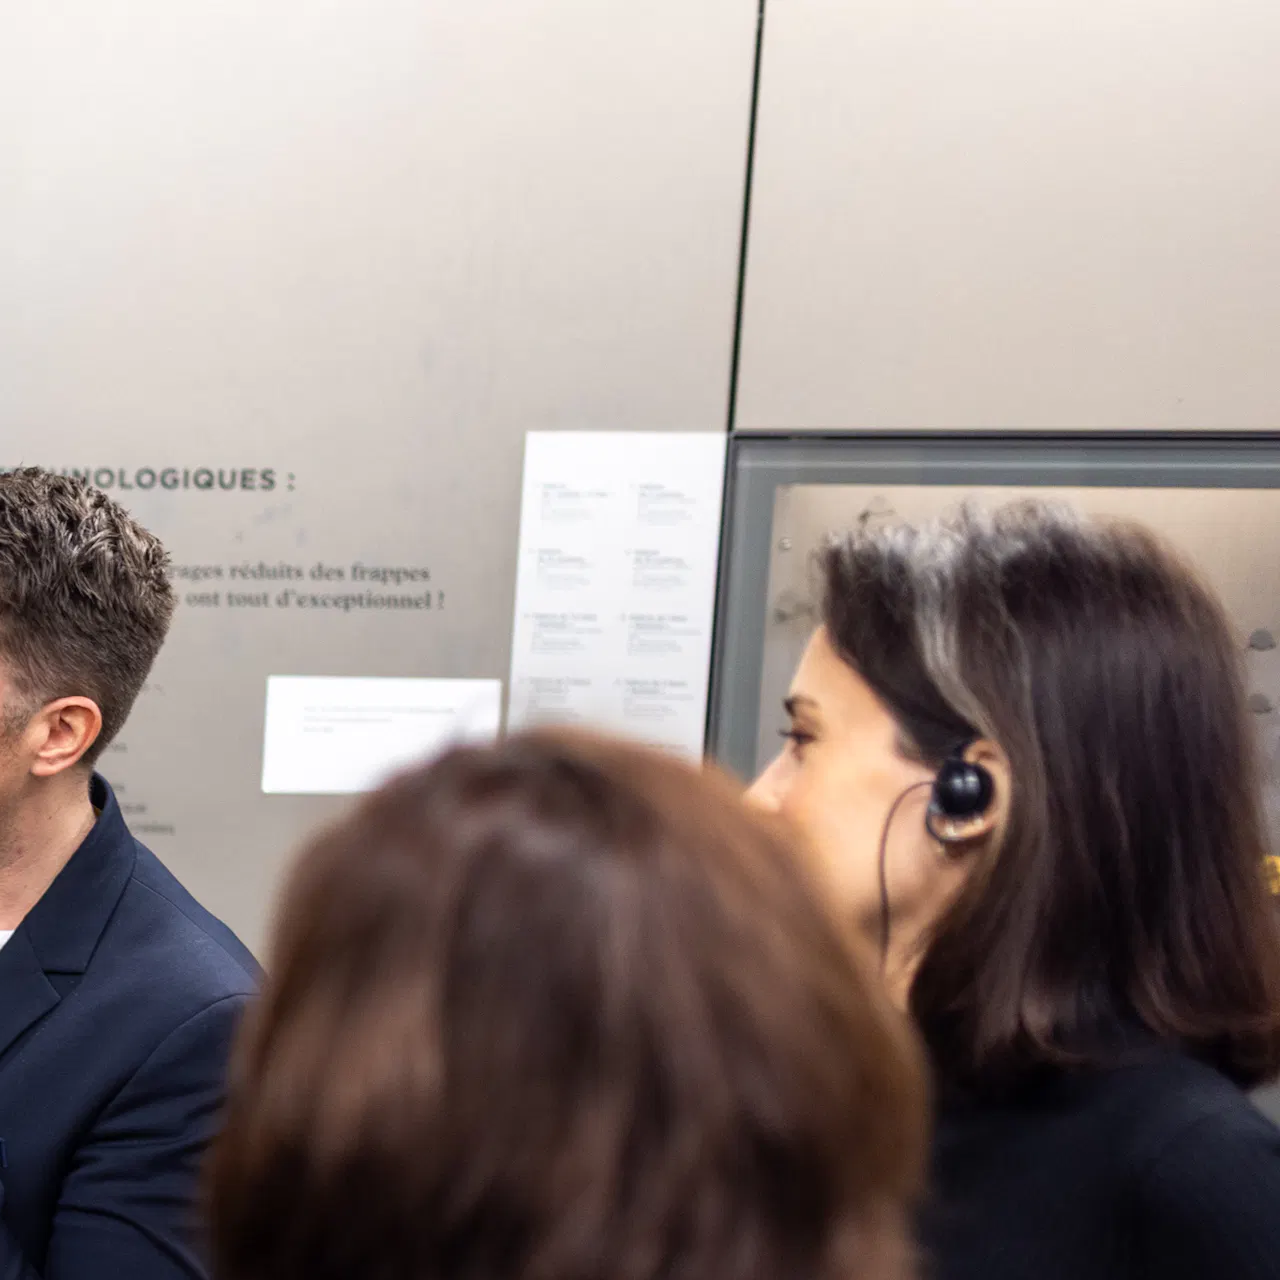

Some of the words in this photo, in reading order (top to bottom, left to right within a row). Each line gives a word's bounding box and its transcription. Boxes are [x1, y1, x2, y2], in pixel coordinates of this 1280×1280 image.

[308, 561, 345, 581] des
[351, 561, 431, 586] frappes
[185, 590, 219, 608] ont
[227, 588, 269, 608] tout
